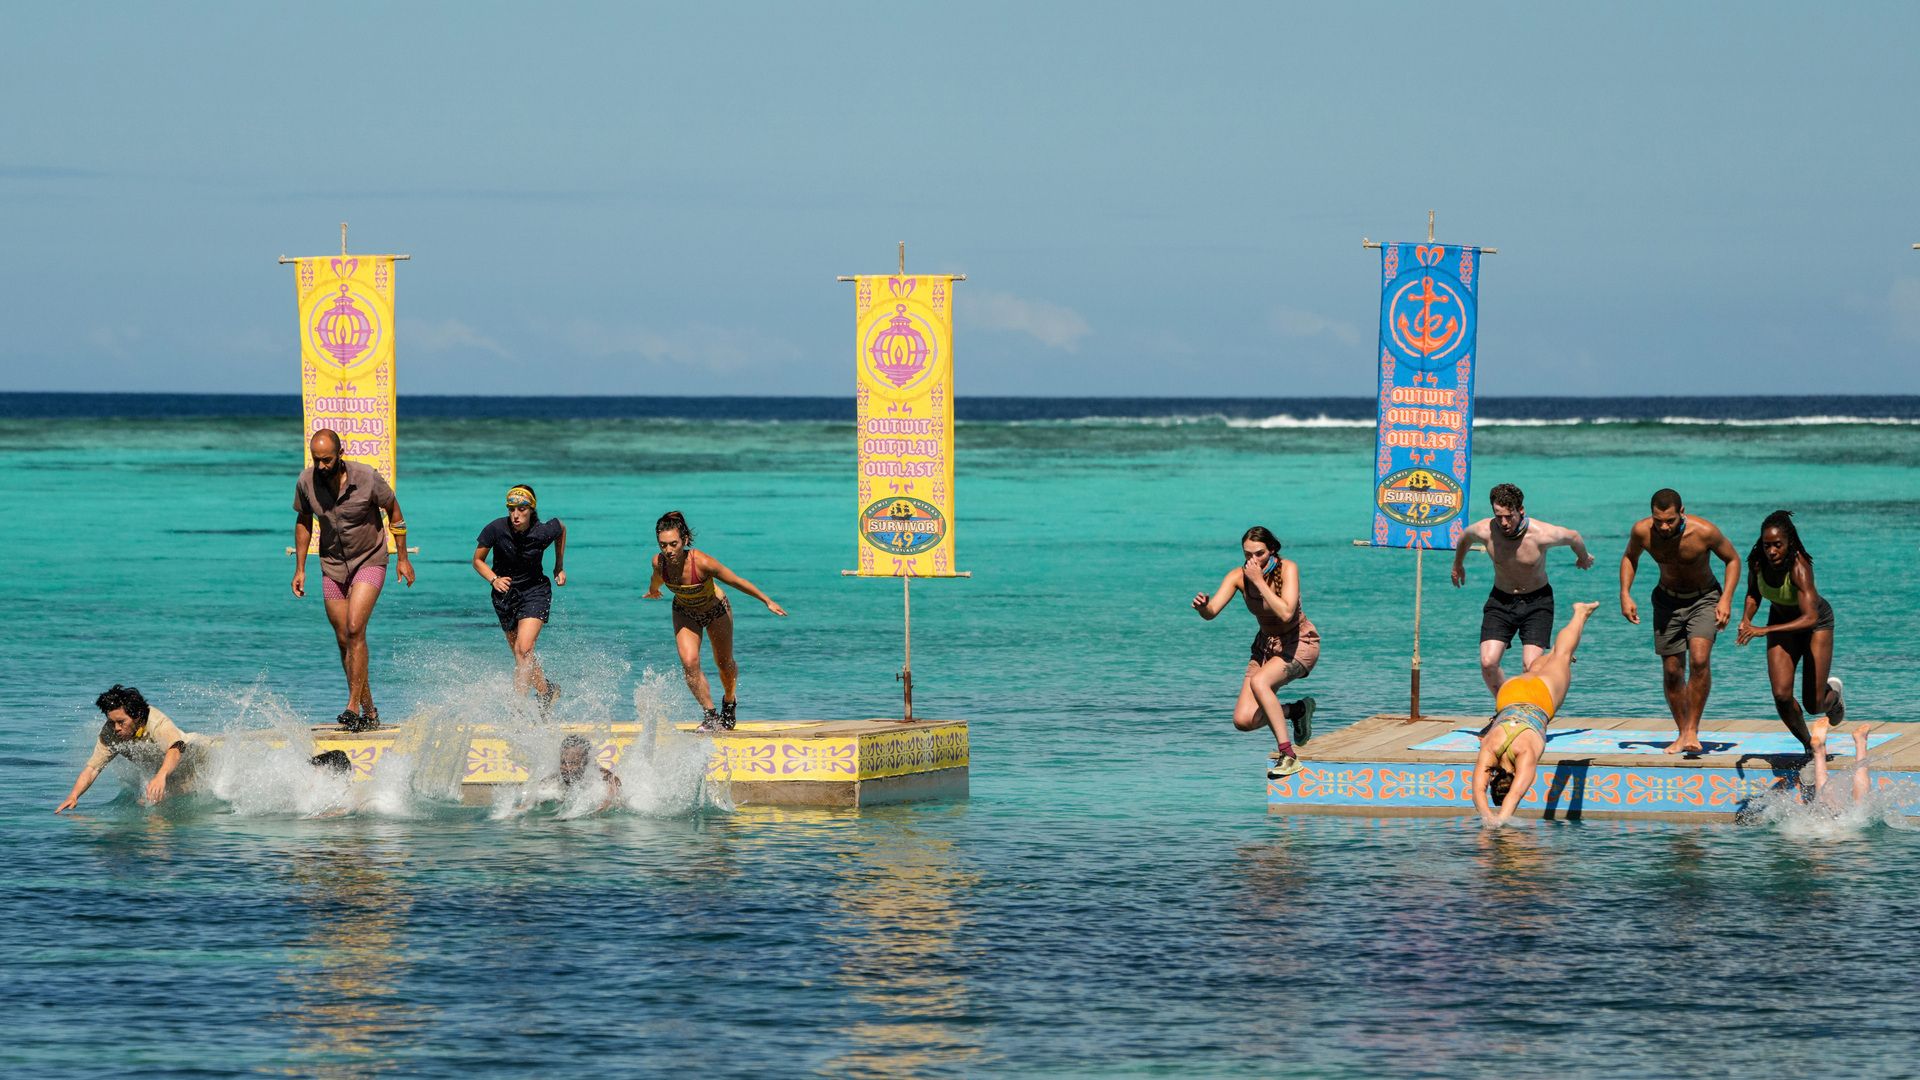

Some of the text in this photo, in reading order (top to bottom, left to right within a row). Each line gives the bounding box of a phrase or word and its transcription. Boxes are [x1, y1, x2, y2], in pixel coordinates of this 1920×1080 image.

[1391, 386, 1456, 407] OUTWIT
[316, 397, 376, 413] OUTWIT
[867, 418, 931, 434] OUTWIT
[1386, 407, 1462, 430] OUTPLAY
[312, 417, 384, 437] OUTPLAY
[341, 440, 380, 456] LAST
[1385, 430, 1459, 450] OUTLAST
[864, 439, 938, 458] OUTPLAY
[865, 461, 936, 477] OUTLAST
[1386, 491, 1453, 505] SURVIVOR
[1407, 503, 1431, 519] 49
[870, 520, 935, 532] SURVIVOR
[891, 532, 914, 548] 49
